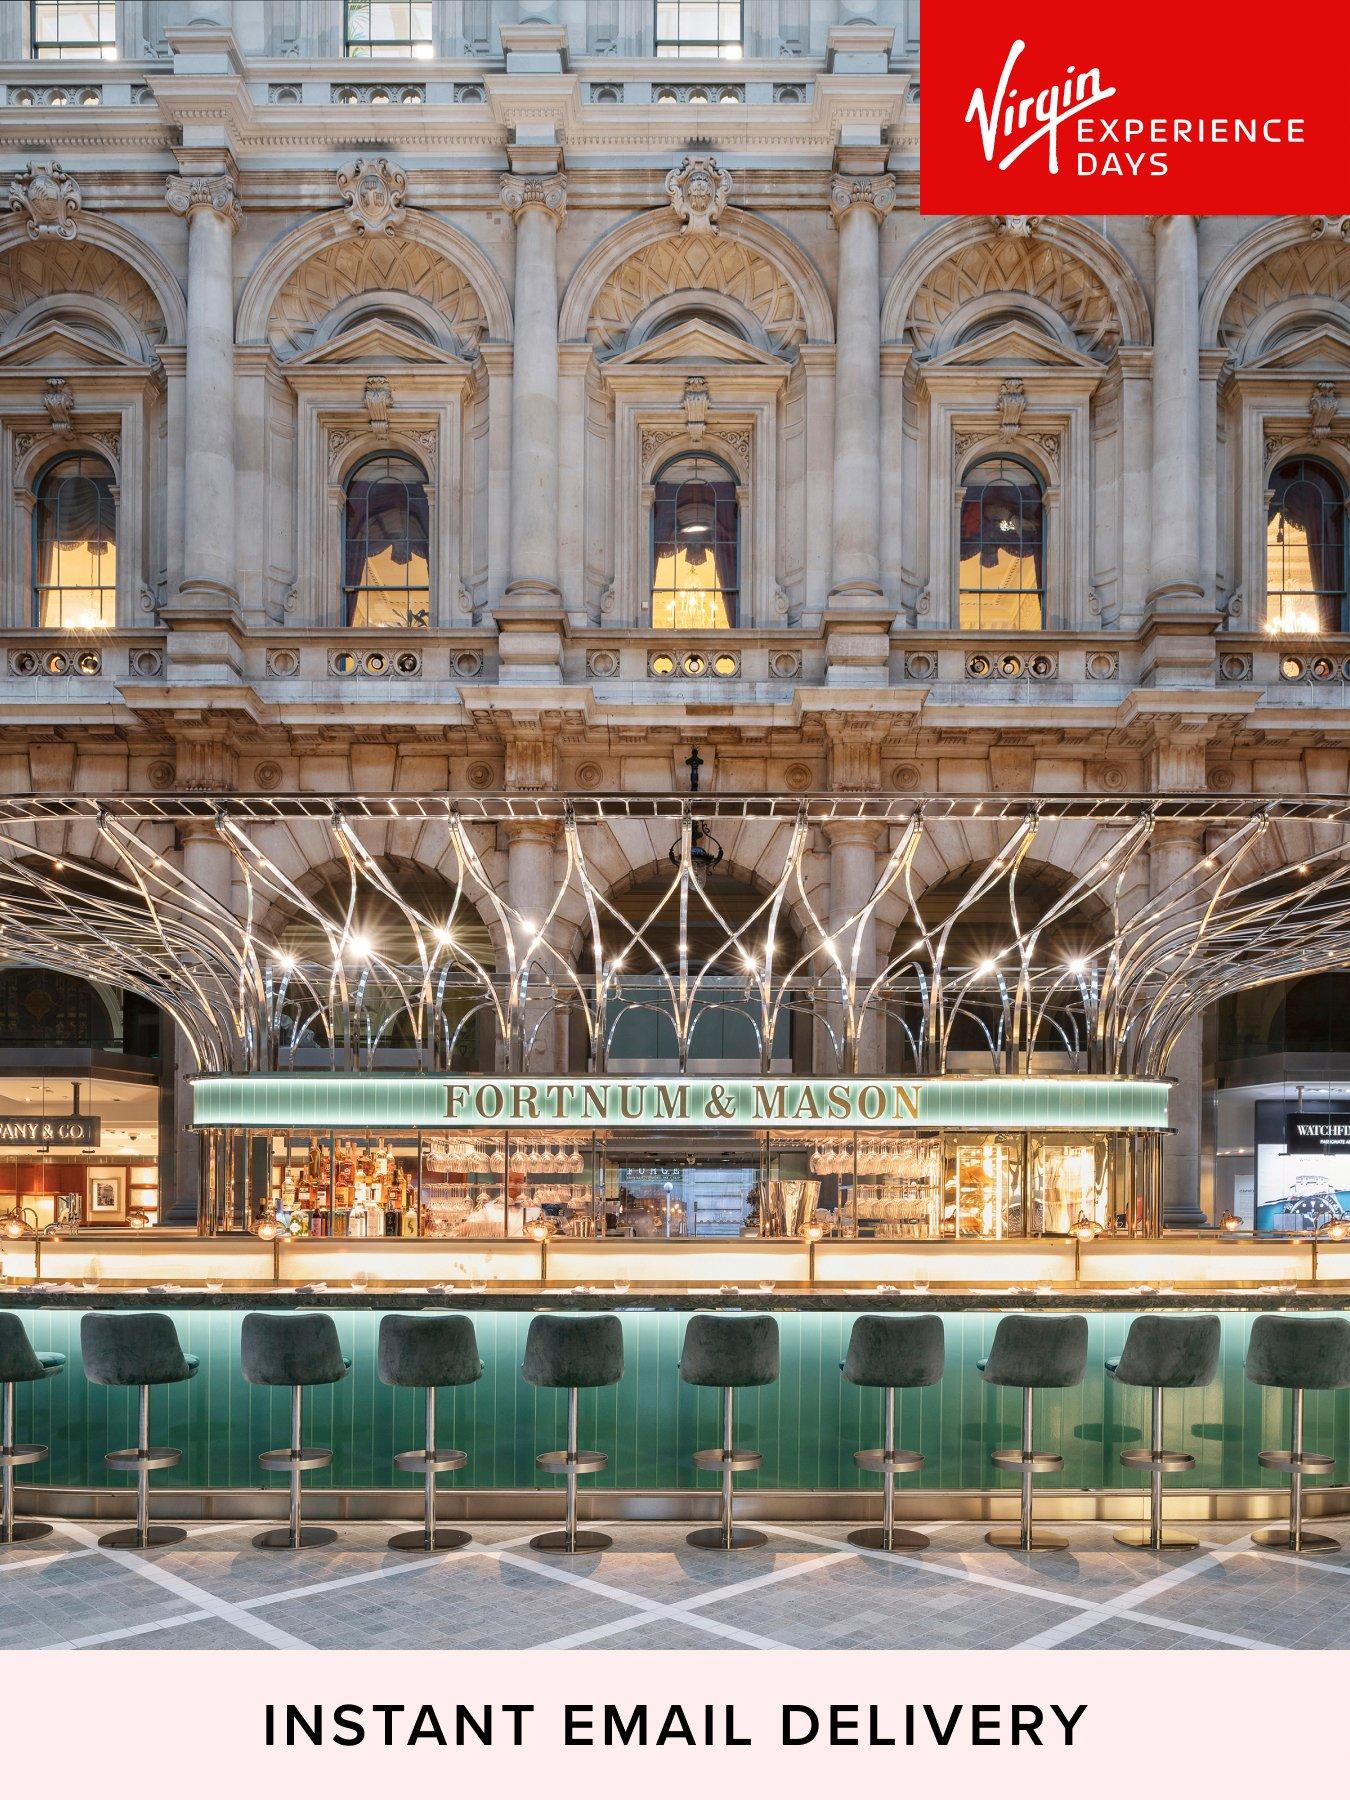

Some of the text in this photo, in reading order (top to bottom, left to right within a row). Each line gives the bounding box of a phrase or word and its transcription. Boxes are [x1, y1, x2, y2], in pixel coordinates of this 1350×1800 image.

[443, 1084, 922, 1119] FORTNUM & MASON
[42, 1123, 54, 1139] &
[59, 1124, 85, 1139] CO.
[1297, 1124, 1350, 1136] WATCHFI
